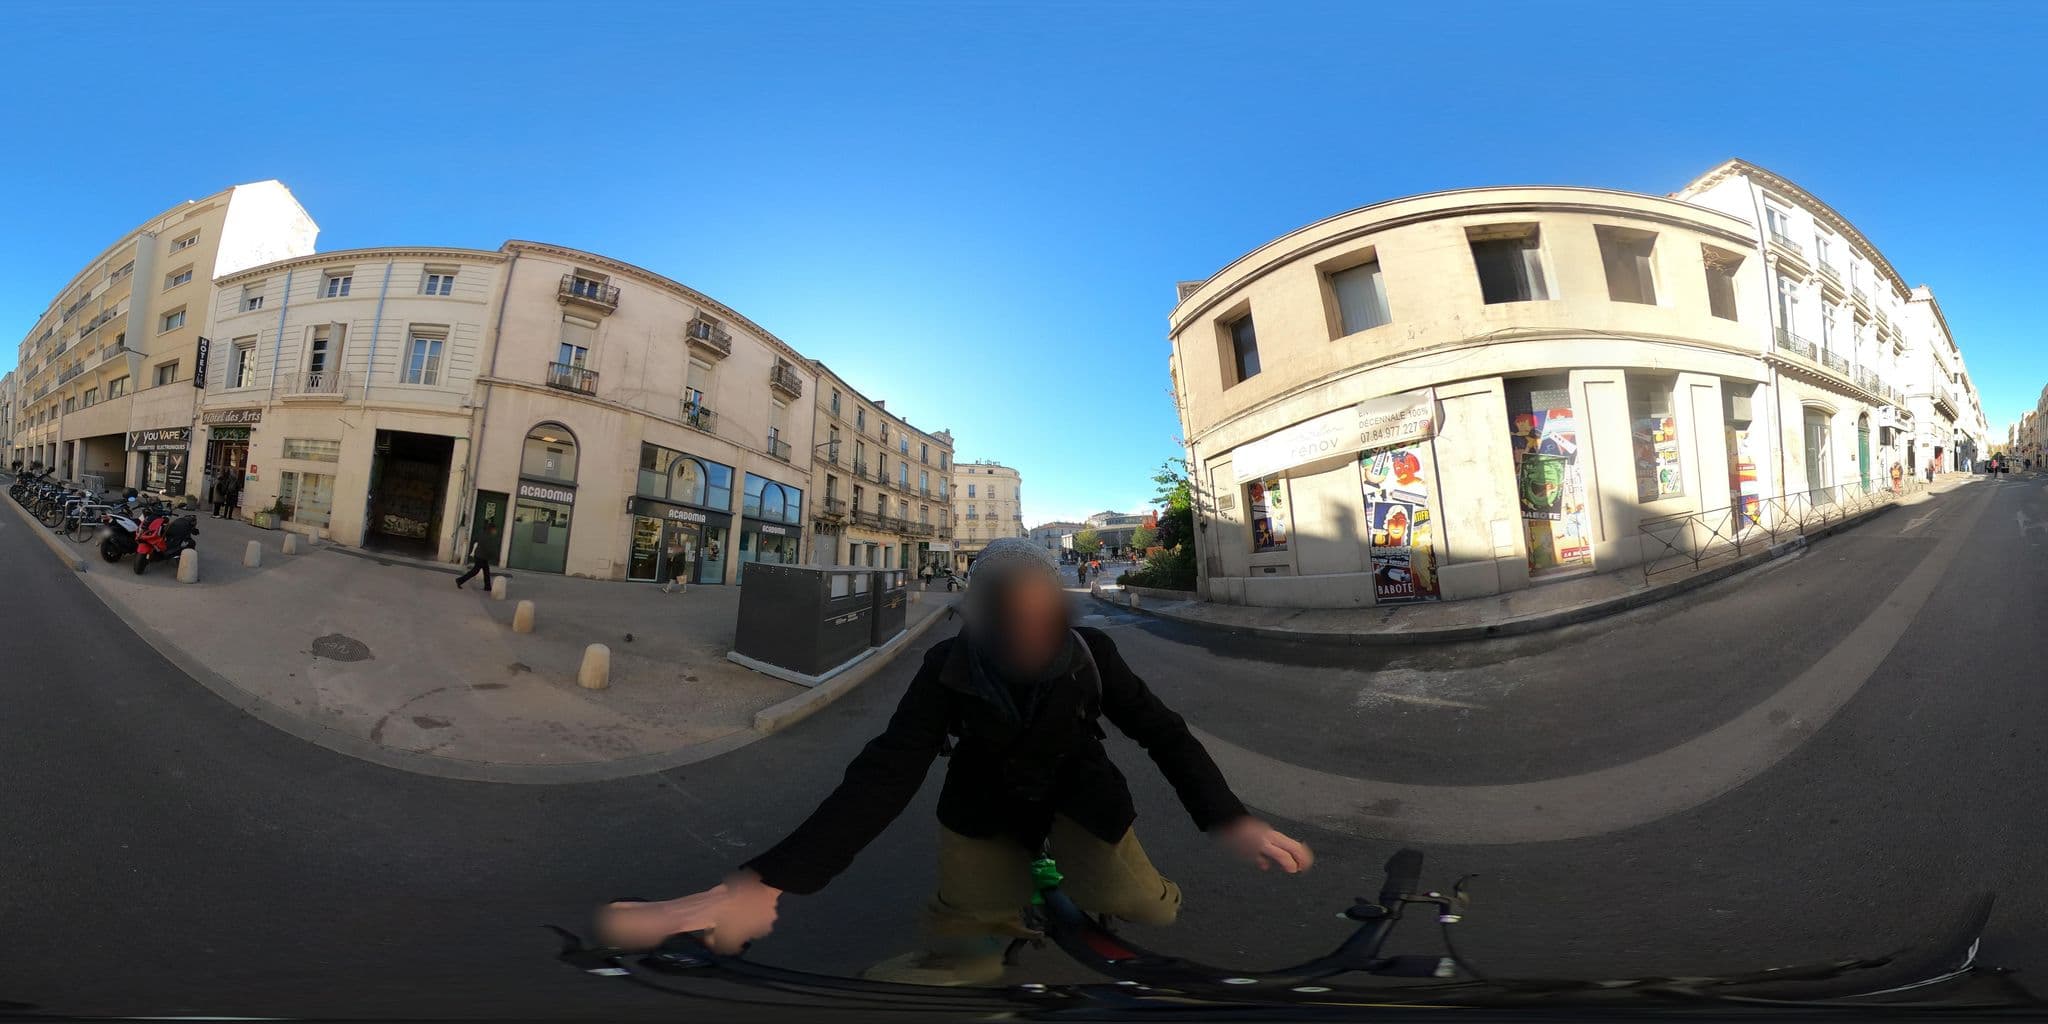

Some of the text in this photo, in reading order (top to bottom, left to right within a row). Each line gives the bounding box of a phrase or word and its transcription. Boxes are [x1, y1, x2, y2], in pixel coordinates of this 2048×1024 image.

[238, 410, 262, 423] Arts
[143, 430, 181, 445] YOU VAPE
[520, 485, 574, 503] ACADOMIA
[668, 509, 707, 524] ACADOMIA
[762, 524, 786, 535] ACADOMIA
[1378, 582, 1414, 595] BABOTE
